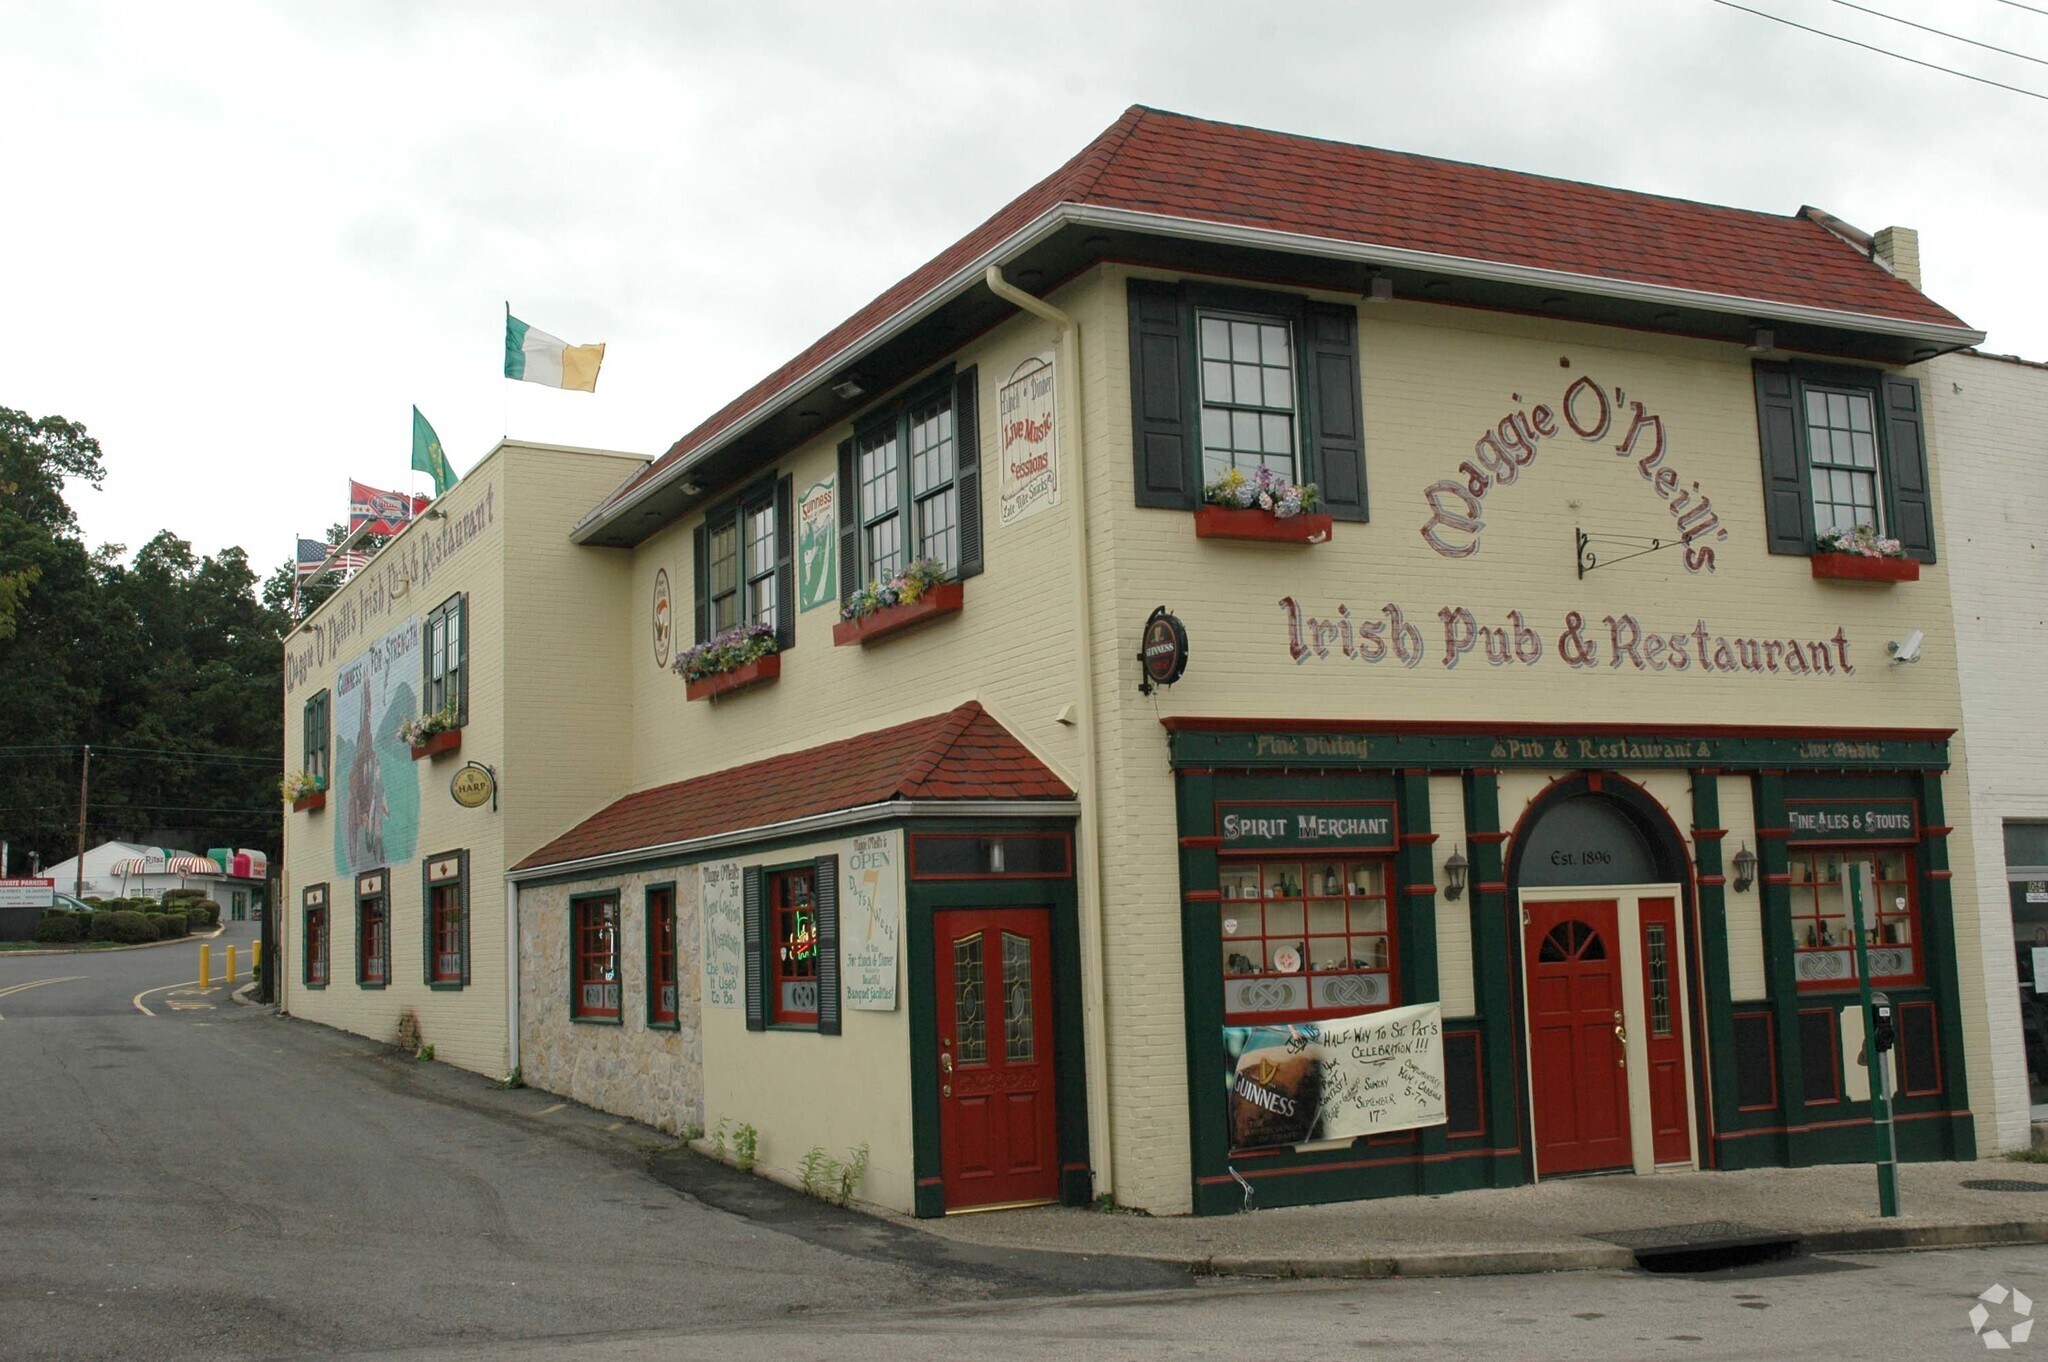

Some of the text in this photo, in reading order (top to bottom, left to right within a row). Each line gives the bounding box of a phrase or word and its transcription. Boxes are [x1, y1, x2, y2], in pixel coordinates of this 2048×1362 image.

[1005, 412, 1052, 449] Live Music
[1420, 392, 1559, 559] Maggie
[1029, 478, 1048, 499] Snacks
[360, 573, 385, 637] Irish
[421, 482, 494, 589] Restaurant
[1278, 595, 1857, 675] Irish Pub & Restaurant
[1256, 735, 1368, 760] Fine Dining
[1507, 738, 1692, 759] Pub & Restaurant
[1800, 742, 1880, 759] Live Music
[458, 782, 486, 793] HARP
[1223, 814, 1389, 839] SPIRIT MERCHANT
[1788, 811, 1911, 833] FINE ALES & STOUTS
[850, 852, 890, 870] OPEN
[1551, 850, 1612, 866] Est. 1896
[0, 879, 48, 887] RIVATE PARKING
[863, 870, 880, 944] 7
[723, 962, 739, 979] Way
[718, 975, 737, 990] Used
[1323, 1027, 1371, 1048] HALF-WAY
[1375, 1025, 1387, 1040] TO
[1364, 1076, 1389, 1091] SUNDAY
[1234, 1072, 1296, 1117] GUINNESS
